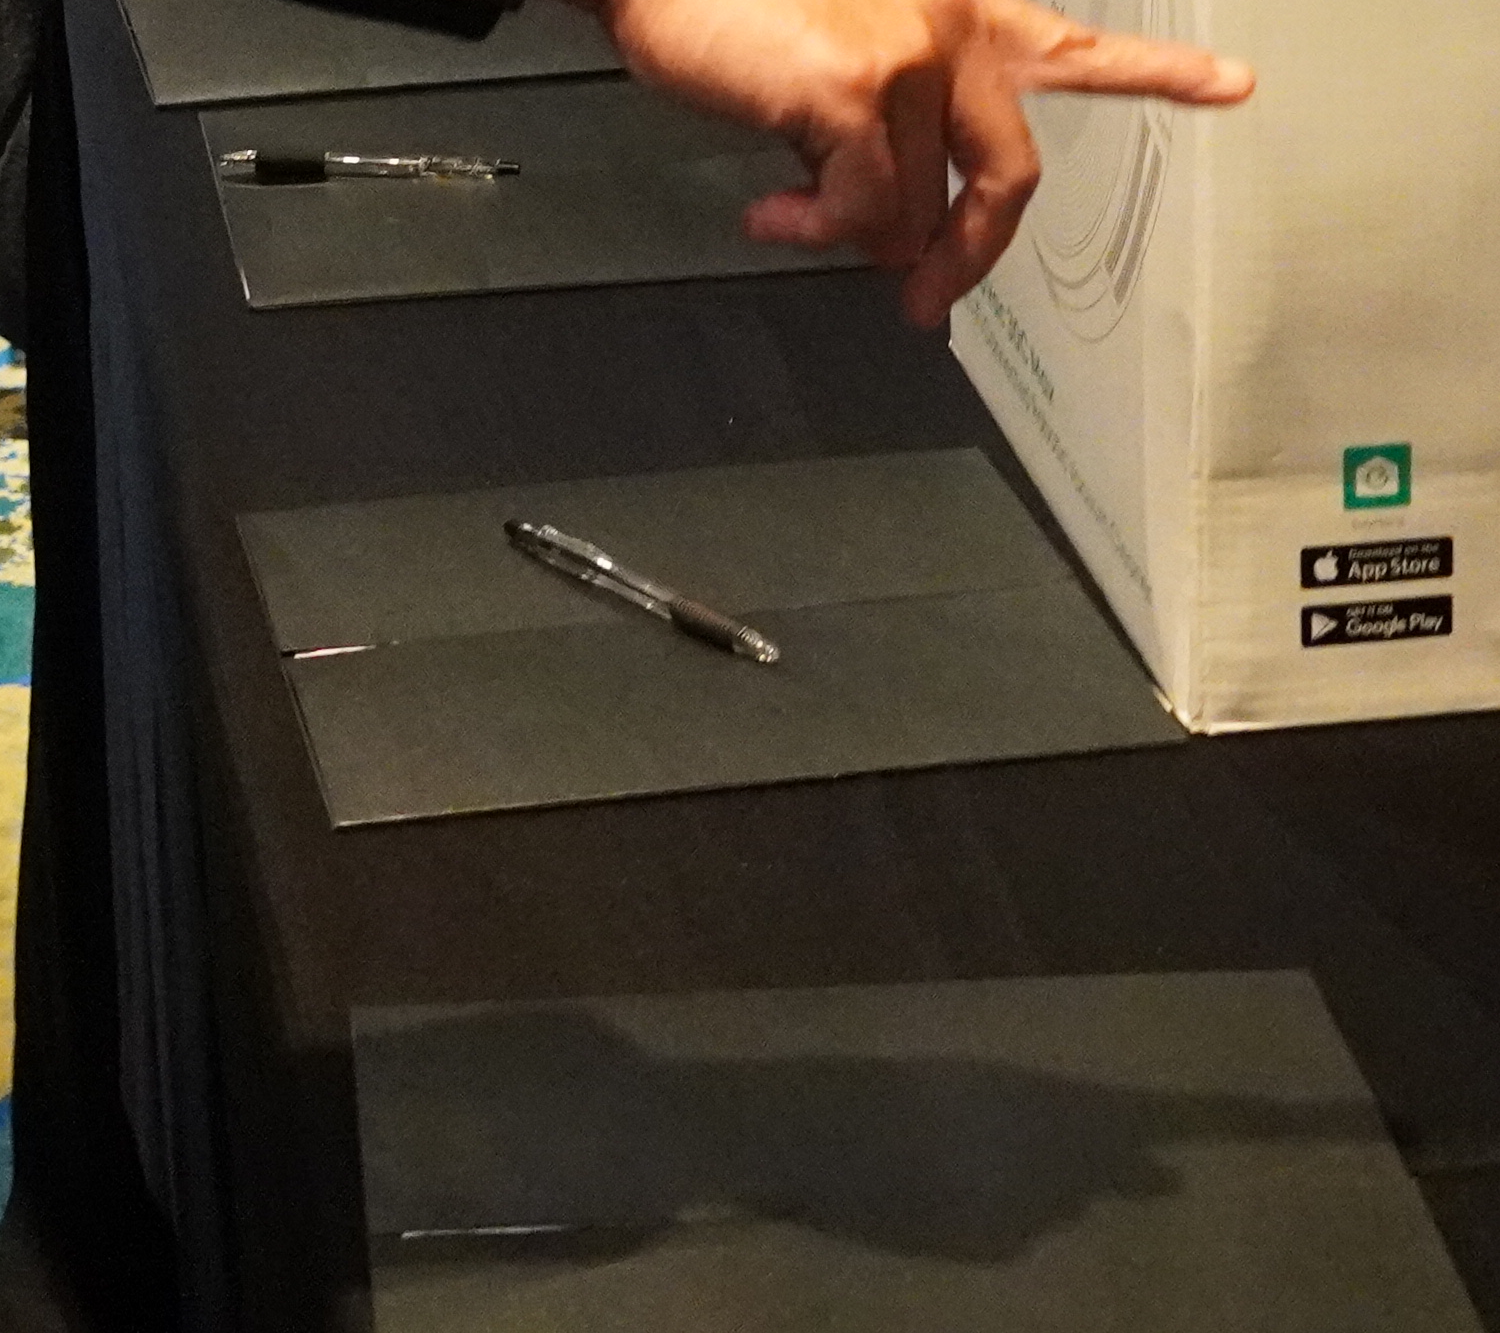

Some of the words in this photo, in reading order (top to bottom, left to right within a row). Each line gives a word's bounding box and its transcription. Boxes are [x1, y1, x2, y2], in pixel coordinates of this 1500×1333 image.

[1348, 559, 1388, 581] App
[1390, 556, 1441, 574] Store
[1345, 616, 1406, 639] Google
[1408, 612, 1444, 632] Play
